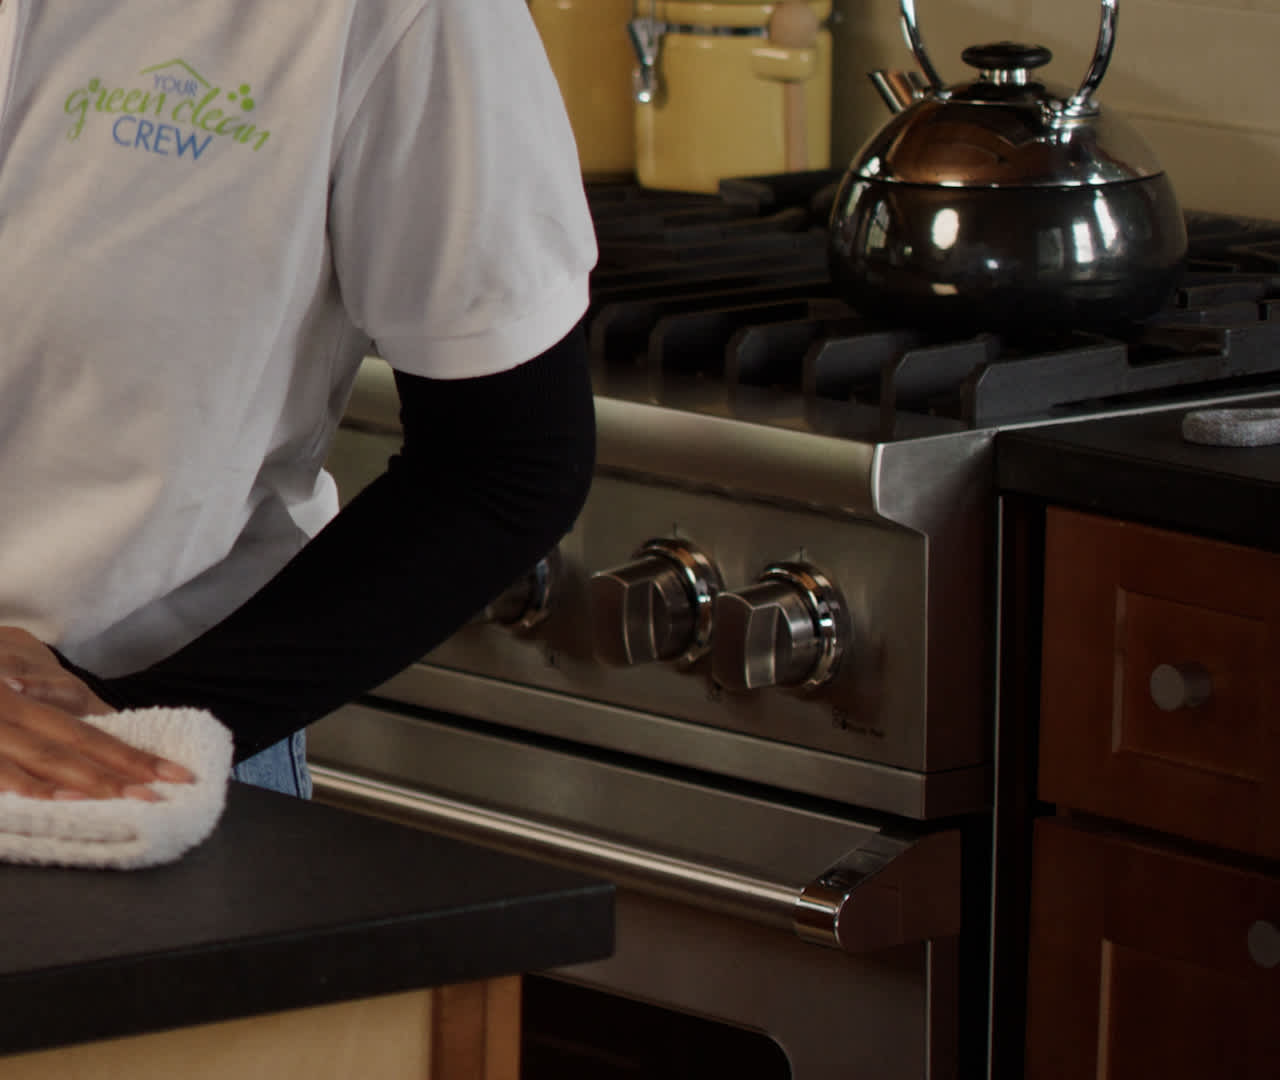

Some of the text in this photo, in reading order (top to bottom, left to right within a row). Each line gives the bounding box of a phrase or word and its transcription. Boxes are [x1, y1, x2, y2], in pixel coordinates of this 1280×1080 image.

[153, 73, 199, 97] YOUR
[63, 77, 271, 152] green clean
[112, 114, 214, 161] CREW
